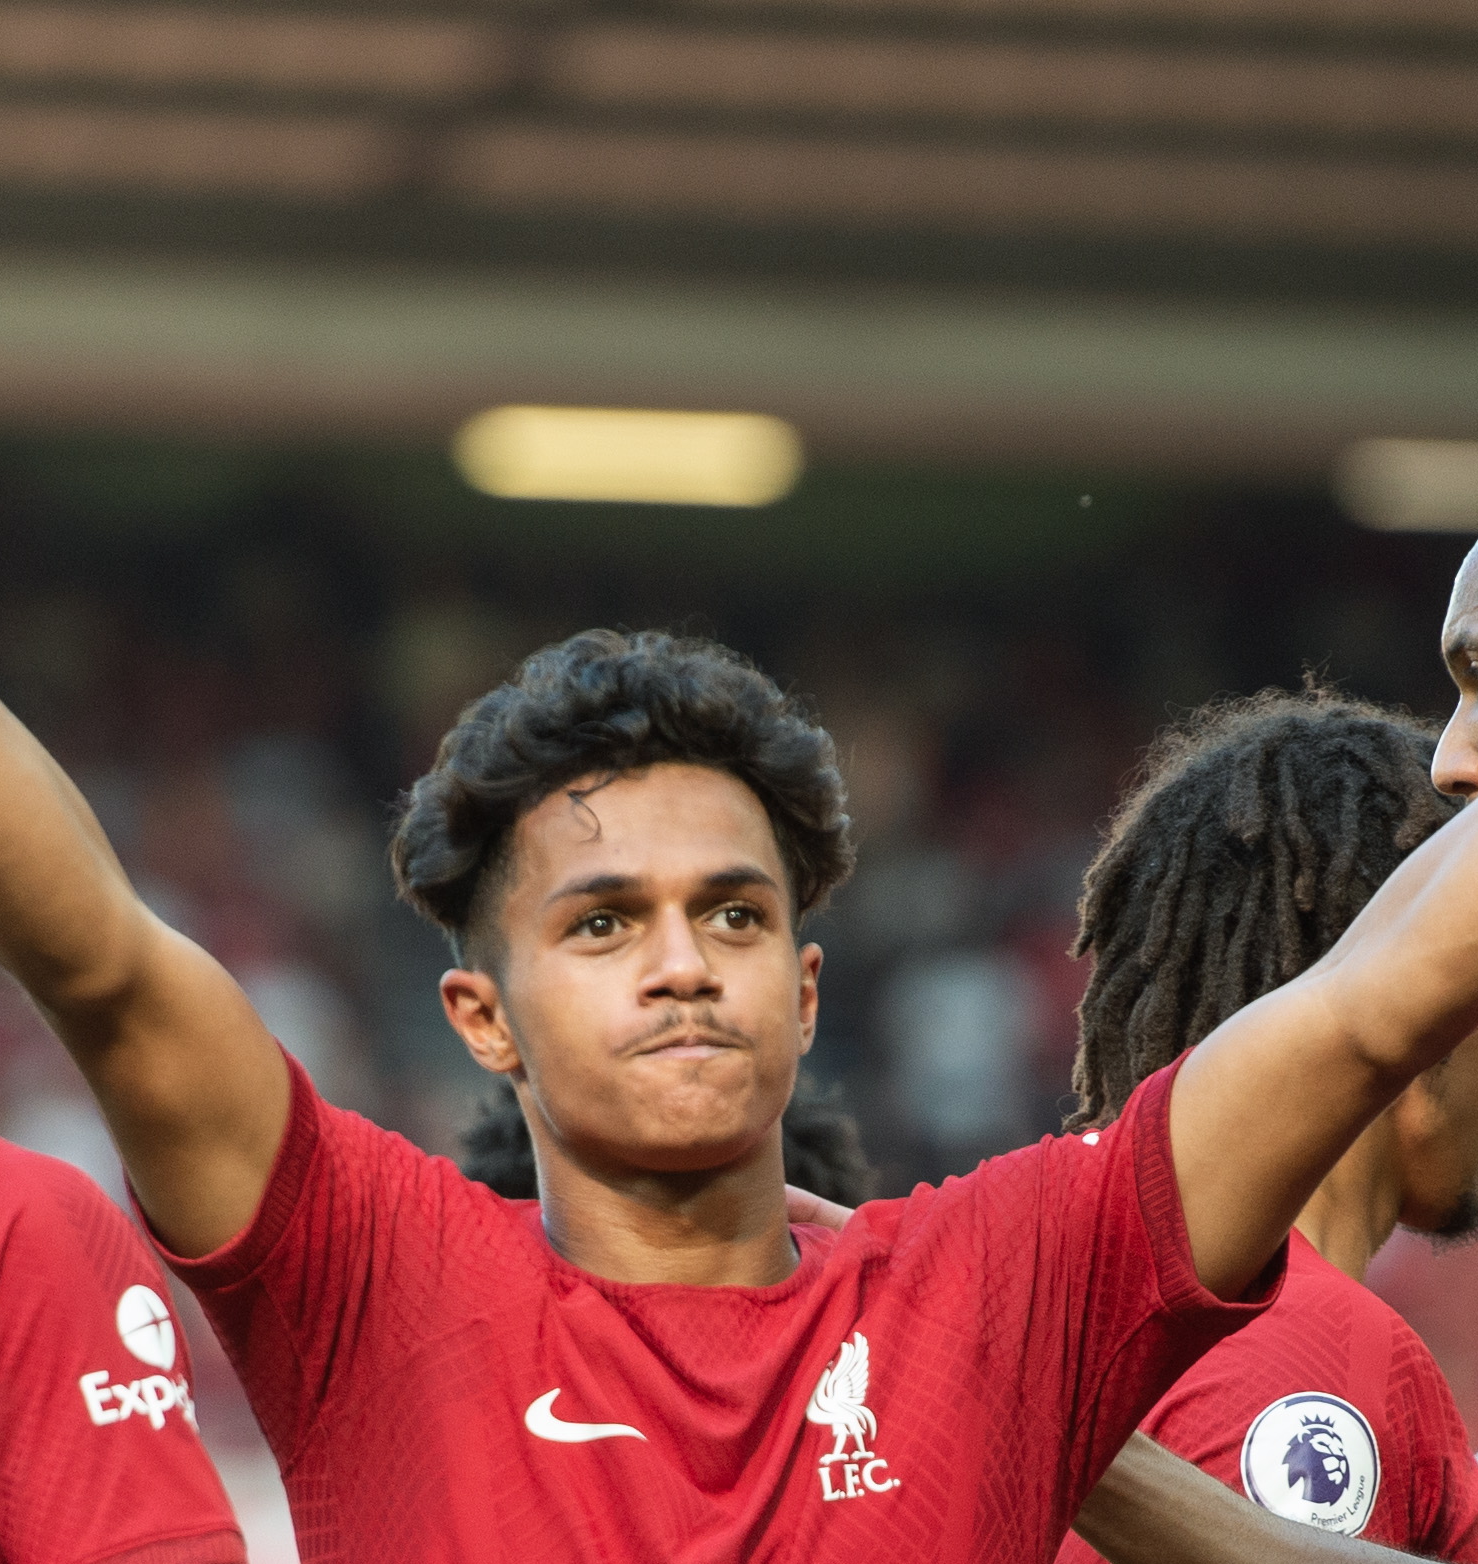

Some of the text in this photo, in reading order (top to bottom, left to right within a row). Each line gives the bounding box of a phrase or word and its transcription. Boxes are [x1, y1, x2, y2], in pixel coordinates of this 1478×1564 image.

[818, 1458, 901, 1502] L.F.C.
[1310, 1474, 1366, 1527] Premier League
